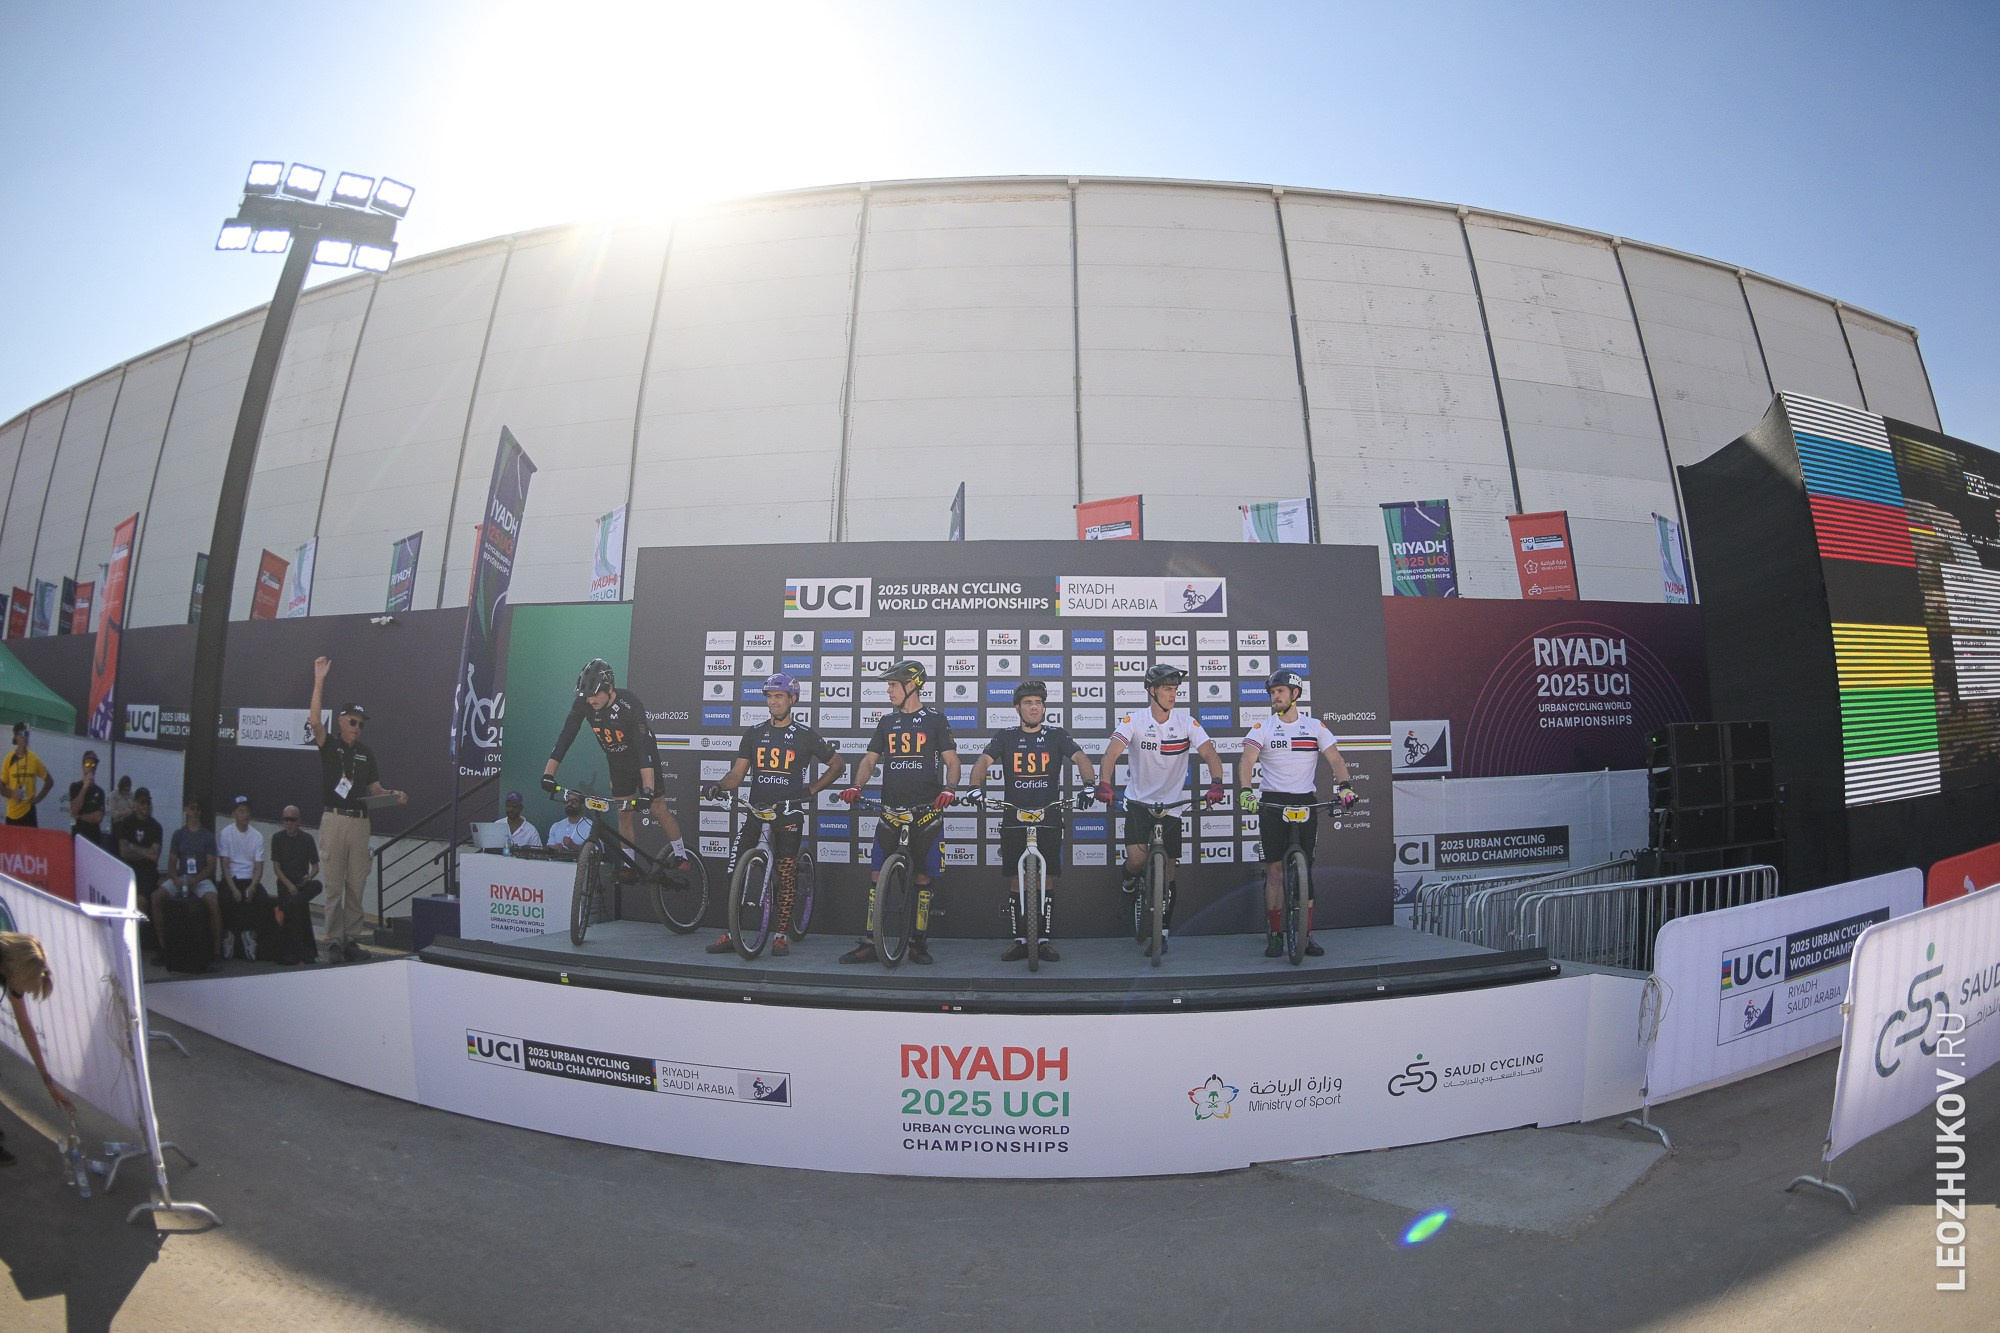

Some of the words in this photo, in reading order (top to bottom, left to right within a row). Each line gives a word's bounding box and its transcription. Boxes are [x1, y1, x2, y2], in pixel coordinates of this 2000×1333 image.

[491, 495, 519, 537] IYADH
[1392, 540, 1447, 556] RIYADH
[1394, 556, 1424, 568] 2025
[1427, 554, 1449, 566] UCI
[591, 574, 617, 592] IYADH
[1396, 573, 1450, 581] CHAMPIONSHIPS
[600, 588, 617, 600] UCI
[879, 584, 909, 596] 2025
[911, 584, 959, 595] URBAN
[961, 583, 1022, 595] CYCLING
[1068, 583, 1115, 595] RIYADH
[800, 585, 863, 611] UCI
[879, 598, 925, 611] WORLD
[928, 597, 1049, 611] CHAMPIONSHIPS
[1068, 598, 1104, 610] SAUDI
[1106, 598, 1157, 610] ARABIA
[909, 635, 934, 646] UCI
[1161, 635, 1186, 646] UCI
[1533, 637, 1627, 666] RIYADH
[1120, 661, 1144, 671] UCI
[826, 687, 849, 697] UCI
[1078, 687, 1102, 697] UCI
[1536, 673, 1590, 697] 2025
[1594, 673, 1631, 696] UCI
[1538, 703, 1568, 713] URBAN
[1568, 702, 1604, 711] CYCLING
[1604, 701, 1632, 711] WORLD
[131, 711, 157, 733] UCI
[161, 712, 174, 721] 2025
[174, 713, 190, 723] URBA
[242, 715, 268, 727] RIYADH
[645, 711, 689, 722] Riyadh2025
[1046, 713, 1061, 723] CI
[1323, 711, 1376, 723] #Riyadh2025
[1539, 714, 1633, 728] CHAMPIONSHIPS
[161, 725, 177, 735] WORLD
[241, 728, 262, 740] SAUDI
[264, 729, 290, 742] ARABIA
[712, 740, 731, 748] uci.org
[888, 732, 927, 754] ESP
[1141, 741, 1158, 751] GBR
[1270, 740, 1288, 749] GBR
[757, 747, 796, 769] ESP
[890, 760, 923, 770] Cofidis
[1013, 752, 1050, 773] ESP
[758, 775, 789, 786] Cofidis
[1014, 780, 1048, 789] Cofidis
[1440, 840, 1464, 851] 2025
[1466, 837, 1501, 849] URBAN
[1503, 834, 1546, 847] CYCLING
[1206, 847, 1231, 858] UCI
[1440, 851, 1478, 864] WORLD
[1481, 845, 1564, 862] CHAMPIONSHIPS
[0, 852, 48, 876] IYADH
[490, 884, 544, 904] RIYADH
[490, 902, 519, 917] 2025
[522, 905, 545, 919] UCI
[507, 918, 527, 926] CYCLING
[490, 924, 545, 935] CHAMPIONSHIPS
[1789, 937, 1810, 955] 2025
[1811, 931, 1840, 949] URBAN
[1731, 945, 1781, 987] UCI
[1788, 951, 1821, 971] WORLD
[1787, 979, 1818, 998] RIYADH
[1786, 996, 1811, 1015] SAUDI
[1813, 985, 1841, 1008] ARABIA
[476, 1036, 521, 1063] UCI
[528, 1046, 550, 1058] 2025
[551, 1049, 584, 1064] URBAN
[586, 1055, 630, 1071] CYCLING
[901, 1044, 1069, 1081] RIYADH
[529, 1058, 565, 1074] WORLD
[566, 1064, 652, 1086] CHAMPIONSHIPS
[662, 1066, 699, 1080] RIYADH
[1444, 1062, 1486, 1079] SAUDI
[1490, 1053, 1544, 1072] CYCLING
[662, 1078, 695, 1091] SAUDI
[697, 1082, 735, 1096] ARABIA
[1249, 1078, 1302, 1097] الرياضة
[1307, 1076, 1343, 1093] وزارة
[901, 1088, 993, 1117] 2025
[1003, 1091, 1070, 1118] UCI
[1248, 1096, 1293, 1112] Ministry
[1294, 1096, 1307, 1108] of
[1309, 1093, 1341, 1109] Sport
[902, 1122, 951, 1134] URBAN
[954, 1124, 1016, 1135] CYCLING
[1018, 1125, 1070, 1135] WORLD
[902, 1138, 1070, 1153] CHAMPIONSHIPS
